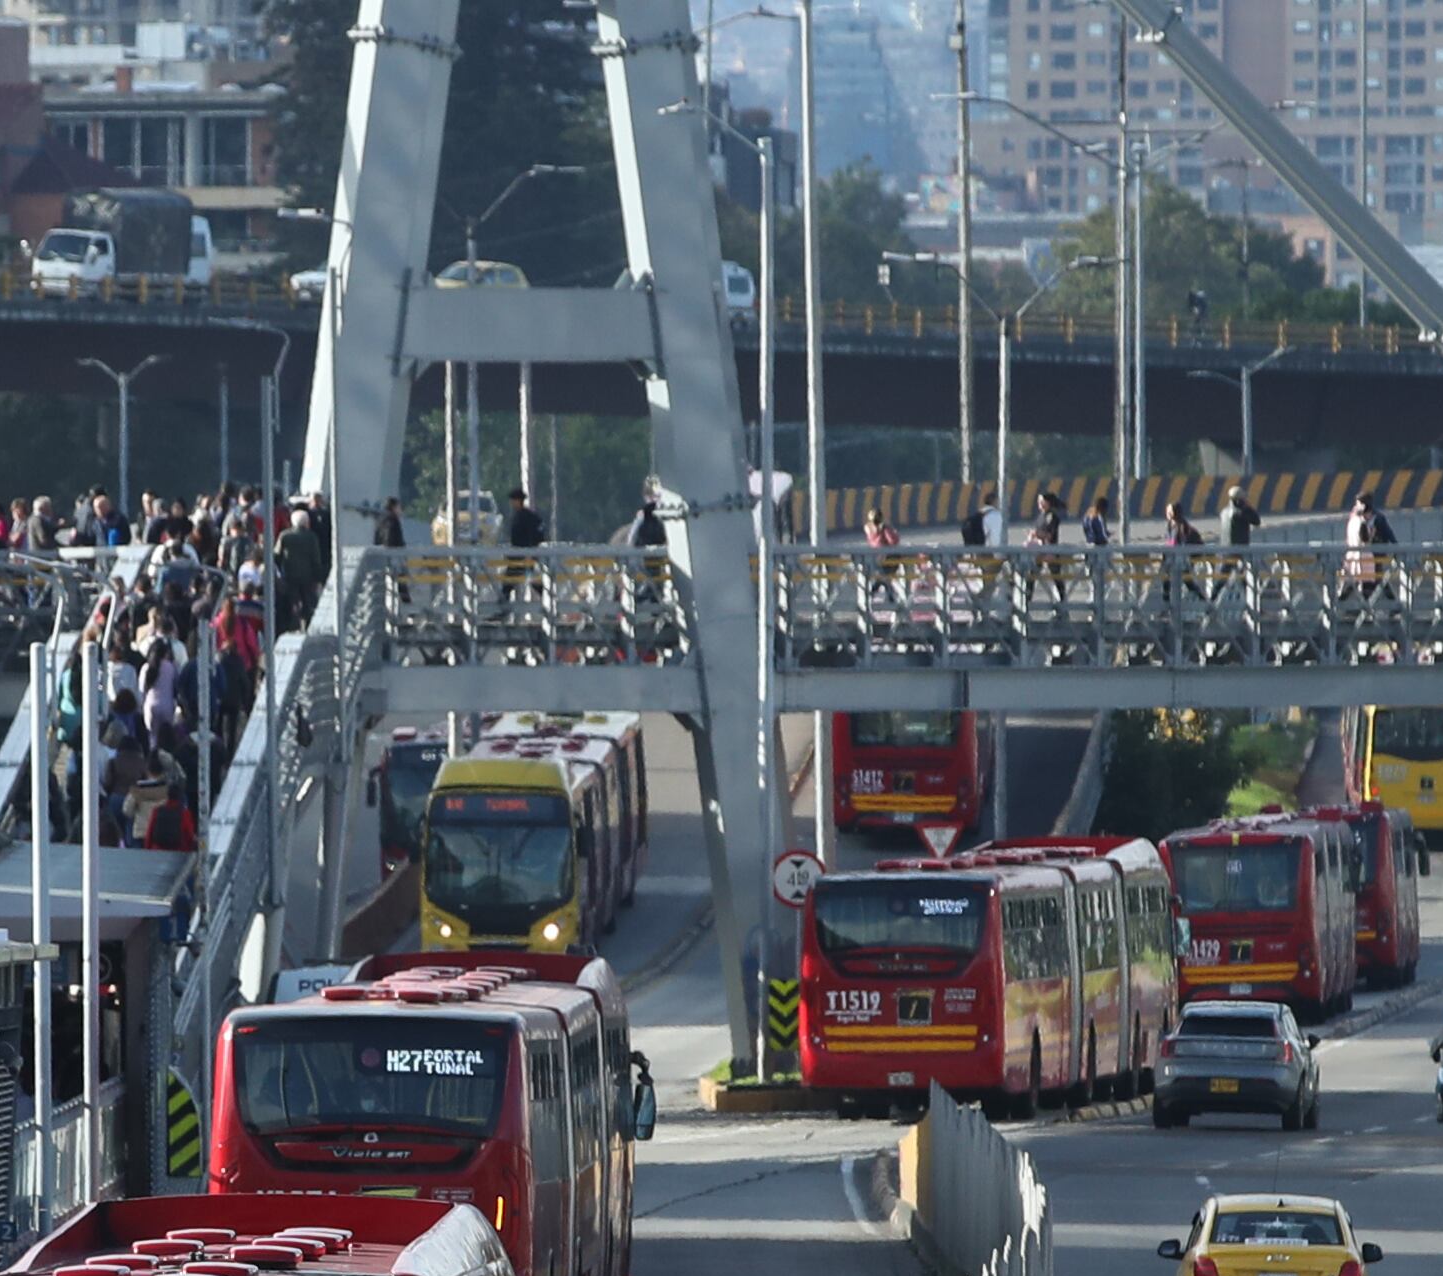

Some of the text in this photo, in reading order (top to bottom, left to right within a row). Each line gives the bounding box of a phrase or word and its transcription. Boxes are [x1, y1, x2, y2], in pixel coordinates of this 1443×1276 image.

[826, 990, 881, 1011] T1519
[386, 1049, 423, 1072] H27
[423, 1049, 484, 1064] PORTAL
[423, 1061, 475, 1076] TUNAL
